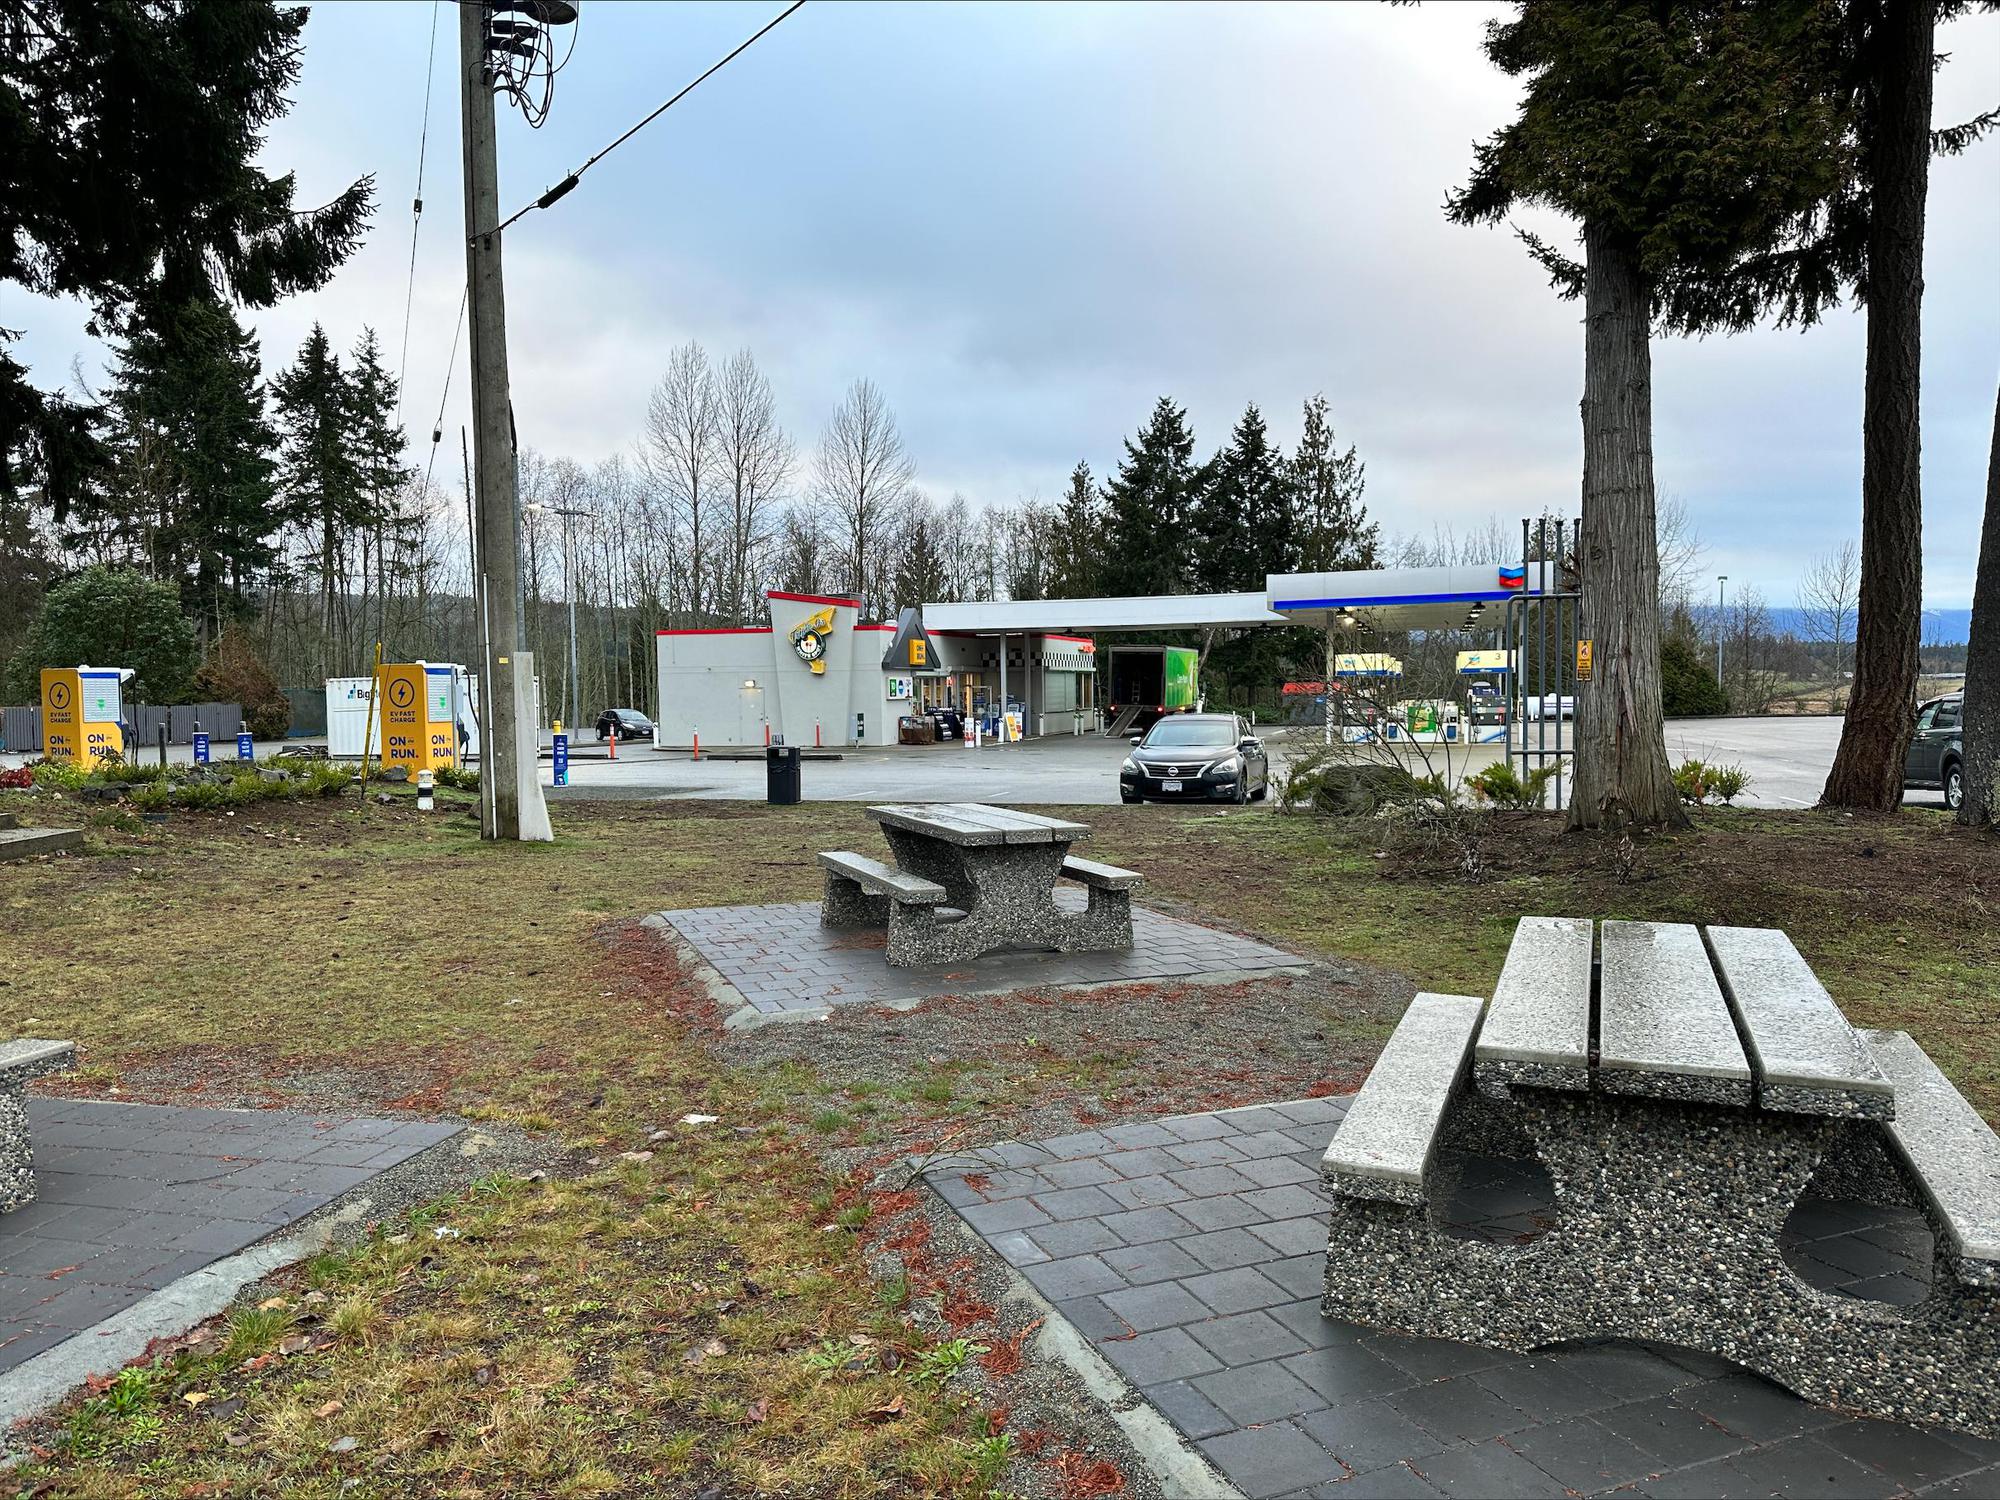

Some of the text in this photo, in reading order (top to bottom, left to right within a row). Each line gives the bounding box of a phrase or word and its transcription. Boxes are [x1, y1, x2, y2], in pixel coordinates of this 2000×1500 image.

[1495, 653, 1501, 661] 3
[49, 735, 64, 745] ON
[87, 733, 105, 743] ON
[389, 736, 406, 746] ON
[431, 734, 445, 744] ON
[51, 746, 75, 756] RUN.
[391, 748, 419, 759] RUN.
